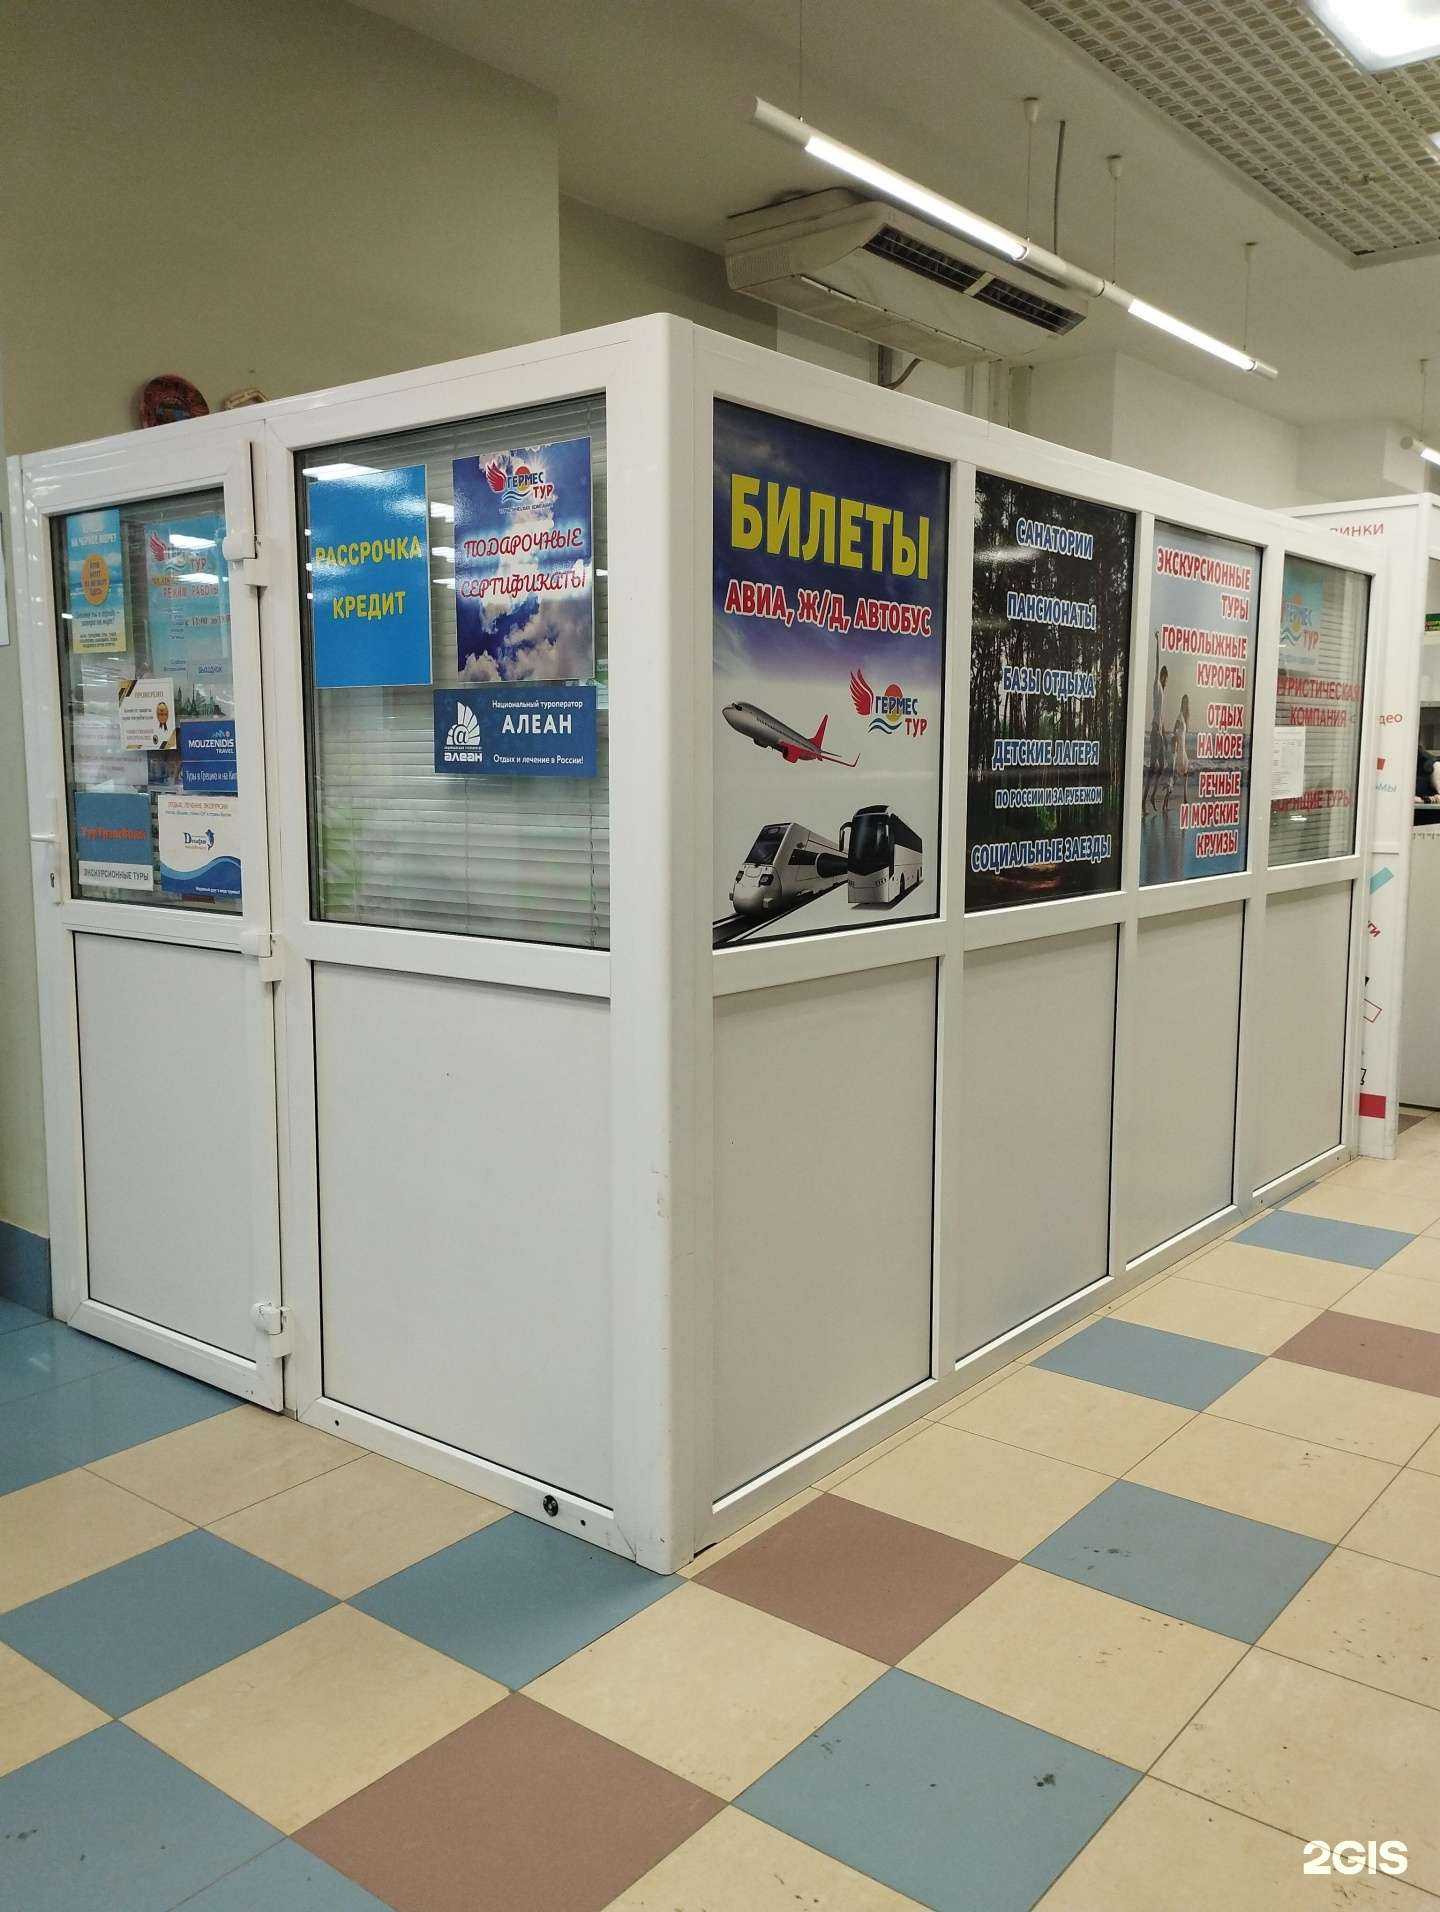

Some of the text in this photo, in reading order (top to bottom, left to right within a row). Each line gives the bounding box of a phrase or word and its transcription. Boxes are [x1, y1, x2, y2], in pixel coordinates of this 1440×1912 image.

[506, 471, 545, 489] ГЕРМЕС
[532, 483, 555, 500] ТУР
[730, 473, 930, 580] БИЛЕТЫ
[1016, 517, 1093, 560] САНАТОРИИ
[1329, 522, 1384, 537] ИНКИ
[315, 535, 423, 568] РАССРОЧКА
[463, 527, 584, 559] ПОДАРОЧНЫЕ
[1156, 545, 1252, 591] ЭКСКУРСИОННЫЕ
[460, 570, 587, 600] СЕРТИФИКАТЫ
[332, 590, 406, 621] КРЕДИТ
[724, 578, 932, 637] АВИА, Ж/Д, АВТОБУС
[1007, 591, 1097, 631] ПАНСИОНАТЫ
[1221, 593, 1249, 621] ТУРЫ
[1161, 624, 1248, 661] ГОРНОЛЫЖНЫЕ
[1002, 665, 1096, 701] БАЗЫ ОТДЫХА
[1196, 661, 1246, 690] КУРОРТЫ
[492, 700, 584, 709] Национальный туроператор
[874, 695, 919, 716] ГЕРМЕС
[1206, 703, 1244, 732] ОТДЫХ
[1290, 705, 1347, 727] КОМПАНИЯ
[501, 714, 573, 734] АЛЕАН
[904, 717, 928, 738] ТУР
[188, 738, 235, 749] MOUZENIDIS
[992, 739, 1100, 771] ДЕТСКИЕ ЛАГЕРЯ
[1197, 732, 1243, 759] НА МОРЕ
[493, 755, 516, 764] Отдых
[523, 756, 550, 765] лечение
[556, 756, 584, 765] России!
[995, 787, 1103, 808] ПО РОССИИ И ЗА РУБЕЖОМ
[1199, 771, 1241, 798] РЕЧНЫЕ
[1180, 801, 1240, 830] И МОРСКИЕ
[972, 835, 1112, 874] СОЦИАЛЬНЫЕ ЗАЕЗДЫ
[1196, 829, 1239, 858] КРУИЗЫ
[83, 868, 149, 881] ЭКСКУРСИОННЫЕ ТУРЫ
